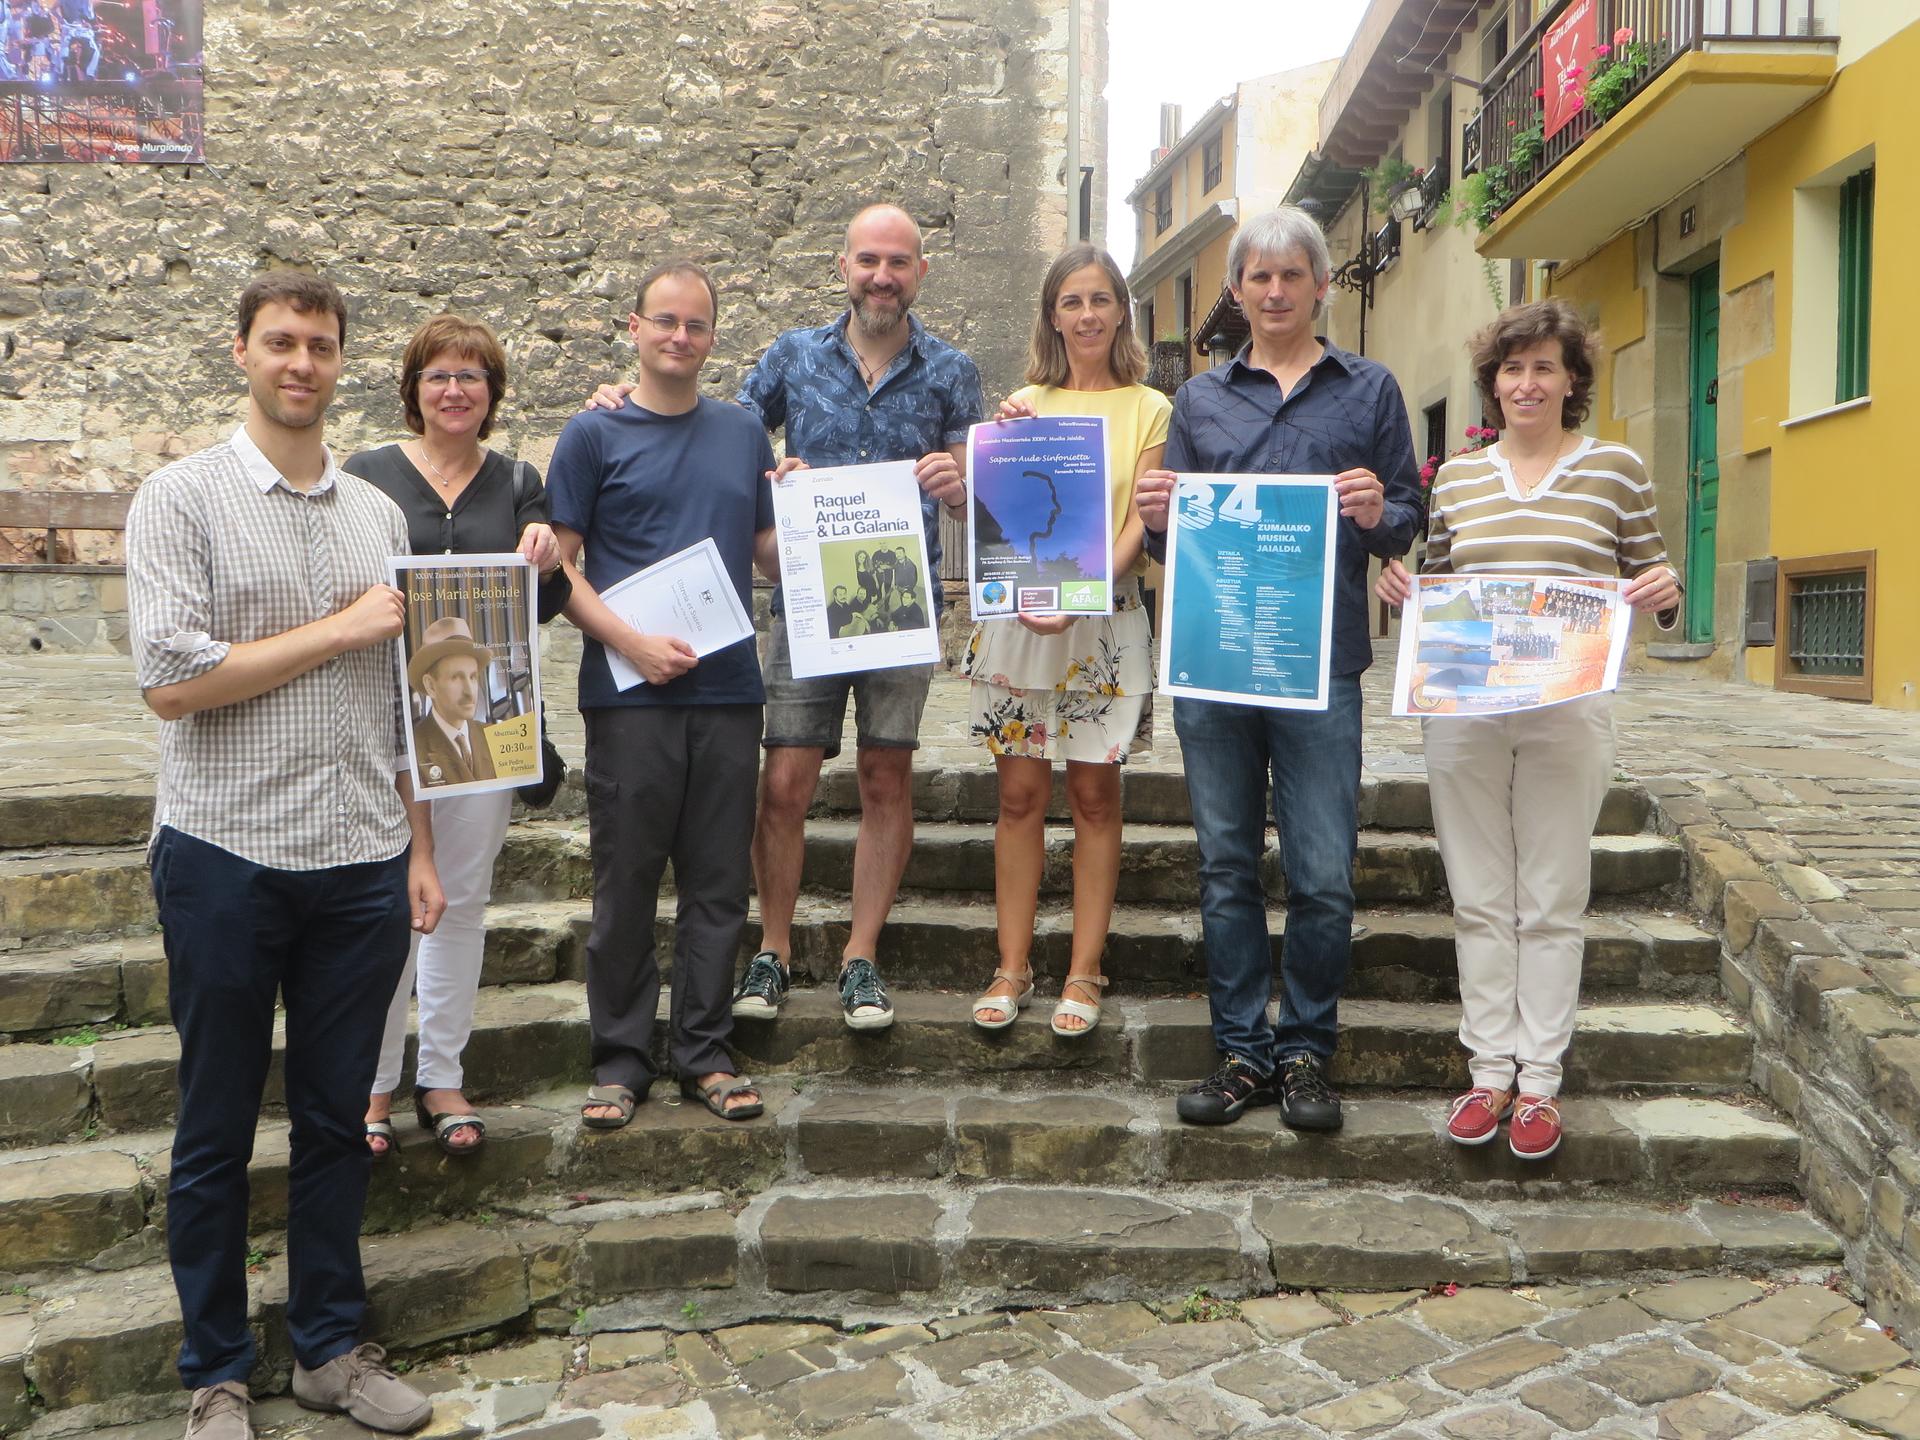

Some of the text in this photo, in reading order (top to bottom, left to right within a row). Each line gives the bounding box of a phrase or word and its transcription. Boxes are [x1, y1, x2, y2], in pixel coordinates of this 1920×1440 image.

[113, 142, 193, 154] Jorge Murgiondo
[988, 453, 1090, 465] Sapere Aude Sinfonietta
[814, 491, 866, 510] Raquel
[1178, 483, 1263, 531] 34
[816, 507, 881, 524] Andueza
[817, 524, 828, 538] &
[832, 523, 850, 536] La
[854, 518, 909, 534] Galanía
[1257, 523, 1312, 533] ZUMAIAKO
[1257, 534, 1297, 543] MUSIKA
[785, 546, 792, 555] 8
[1256, 544, 1302, 553] JAIALDIA
[408, 585, 520, 605] Jose Maria Beobide
[1071, 594, 1103, 604] AFAGI
[519, 723, 528, 737] 3
